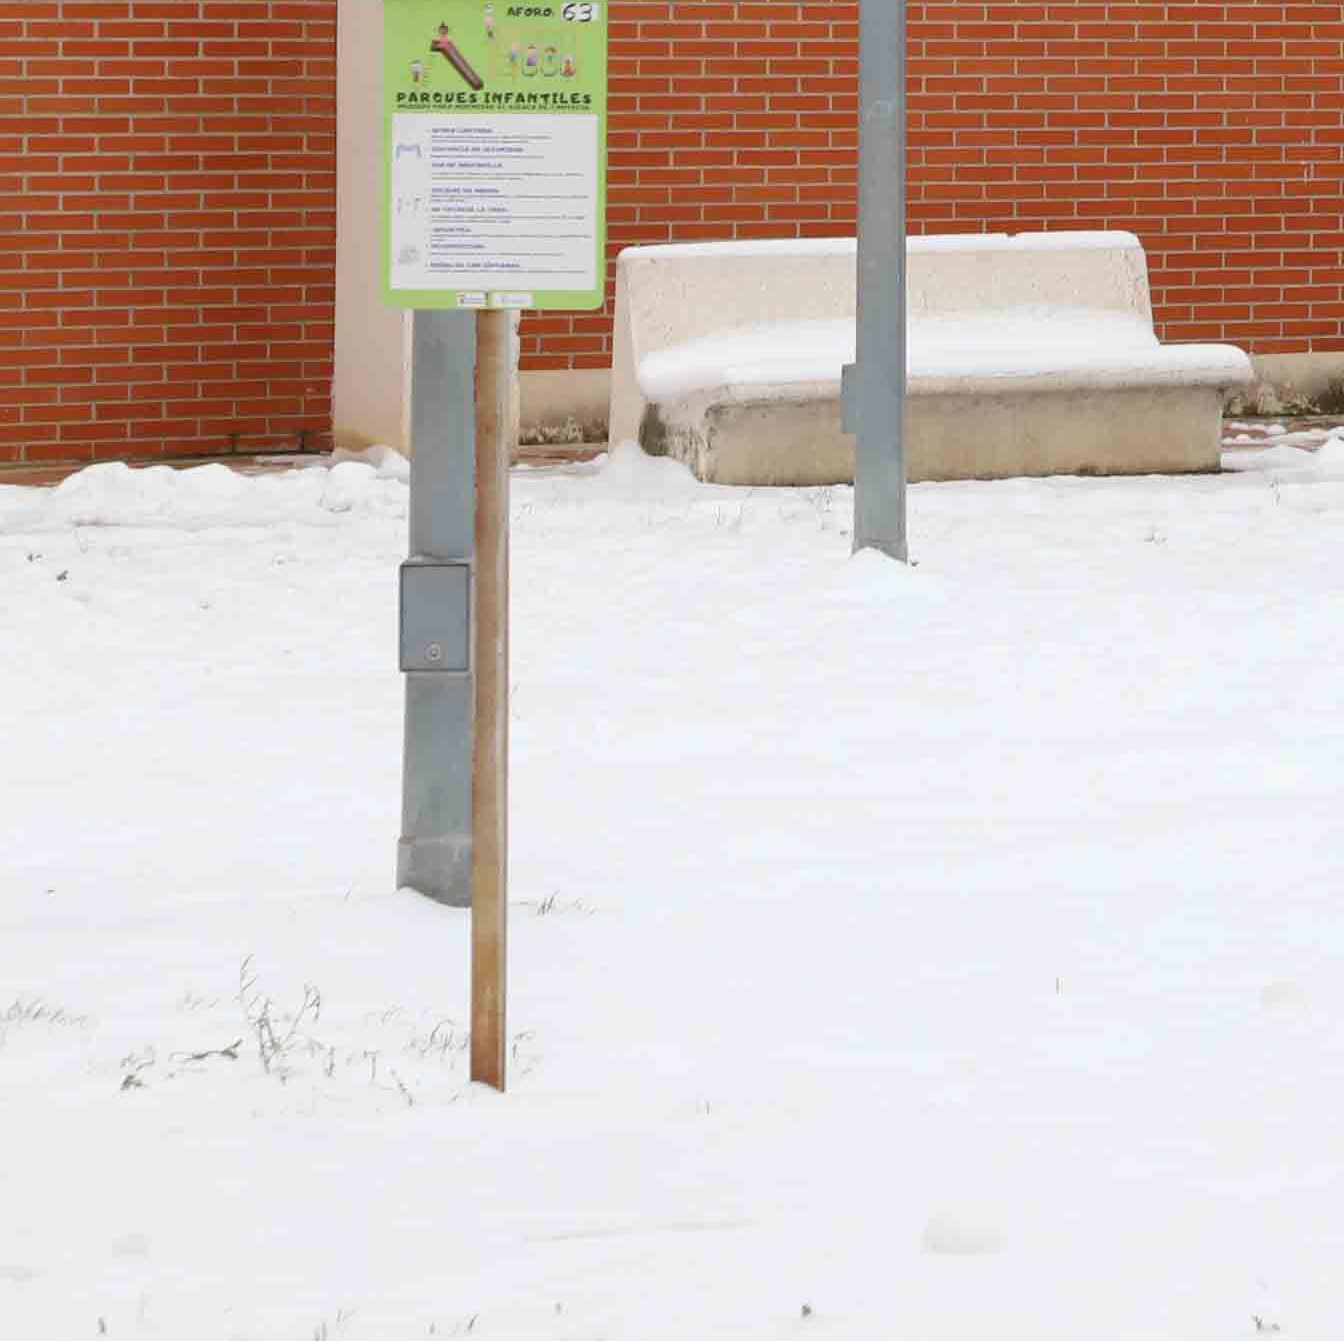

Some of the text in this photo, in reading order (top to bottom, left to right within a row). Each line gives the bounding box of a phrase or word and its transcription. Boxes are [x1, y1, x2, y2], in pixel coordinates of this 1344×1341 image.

[562, 2, 593, 23] 63
[396, 91, 593, 105] PARQUES INFANTILES
